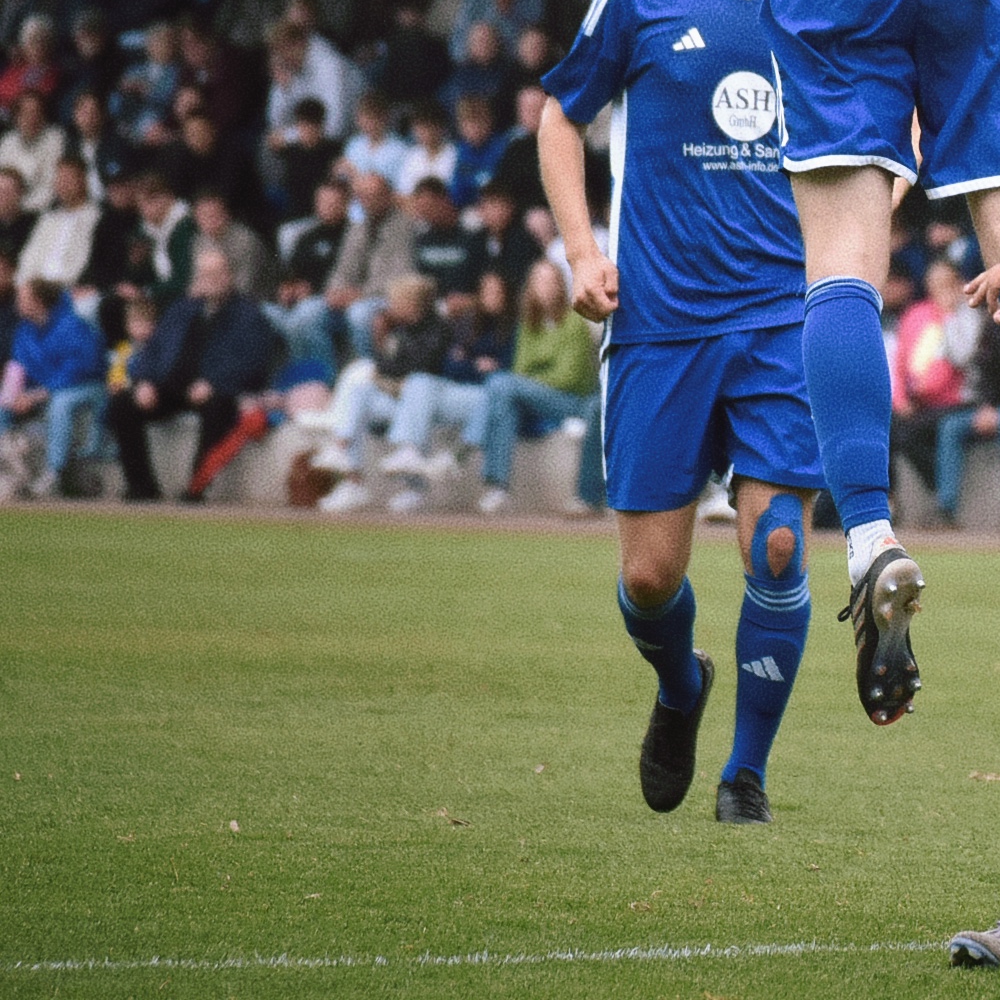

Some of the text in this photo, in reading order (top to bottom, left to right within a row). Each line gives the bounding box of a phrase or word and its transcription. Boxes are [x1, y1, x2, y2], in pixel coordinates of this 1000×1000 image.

[715, 87, 773, 112] ASH
[683, 142, 738, 159] Heizung
[741, 143, 751, 157] &
